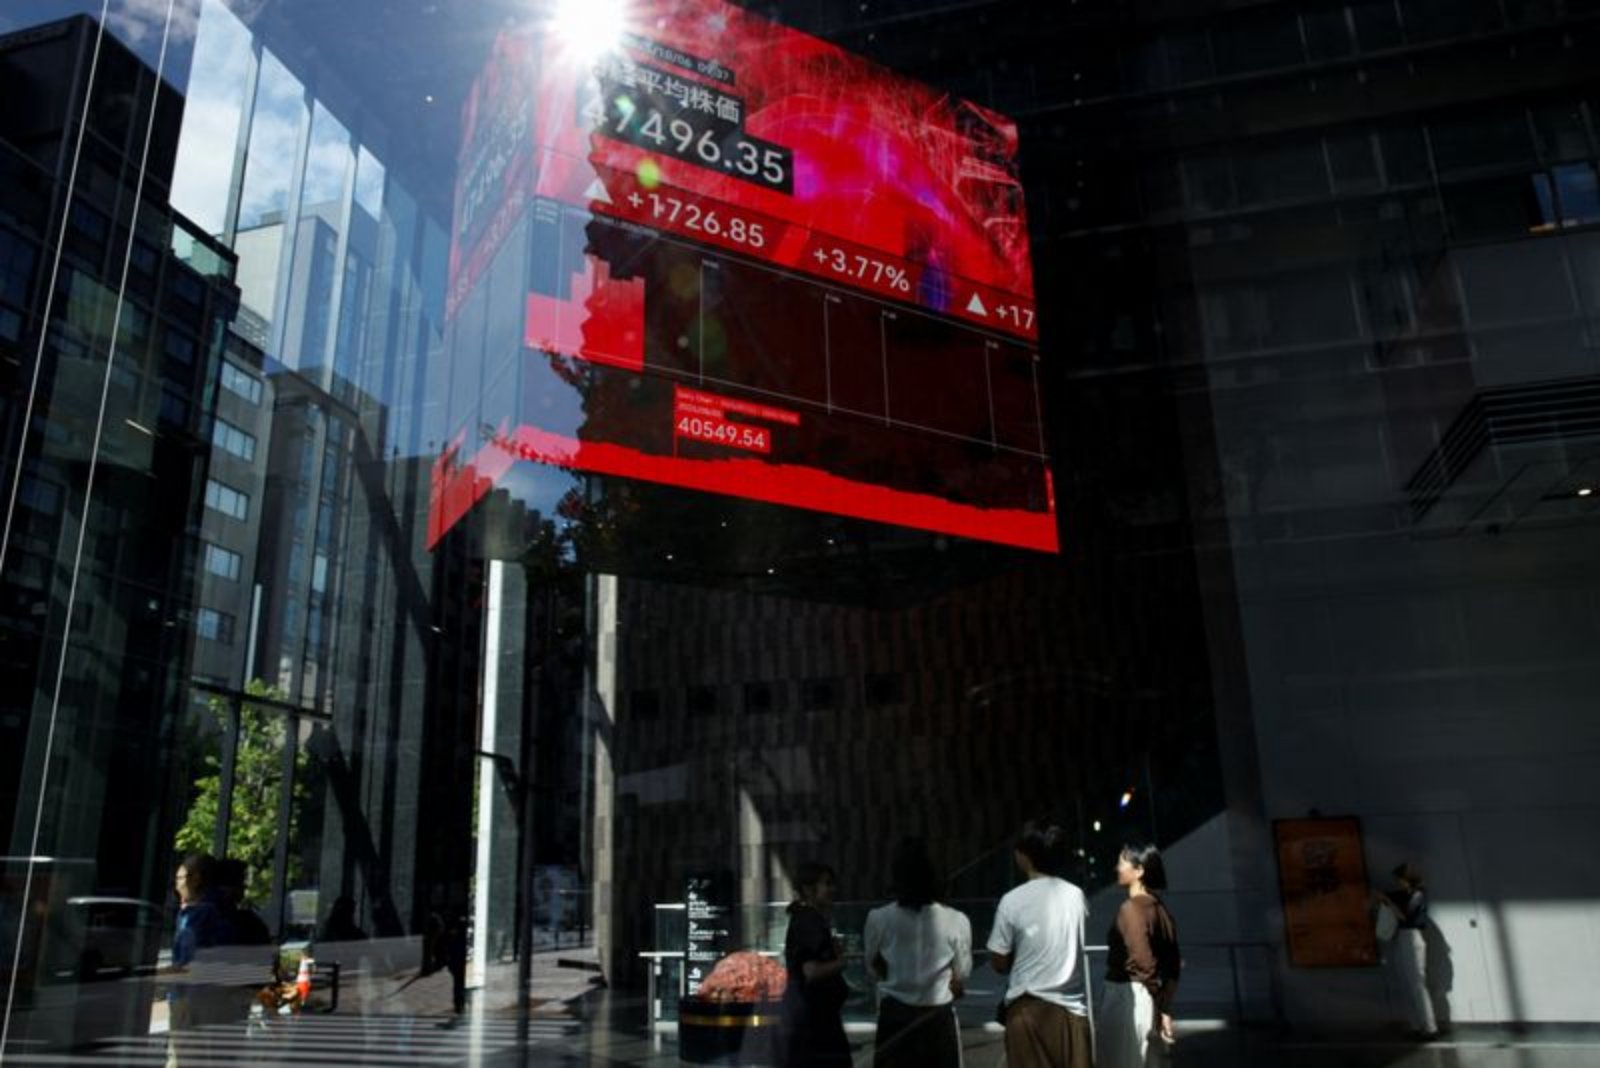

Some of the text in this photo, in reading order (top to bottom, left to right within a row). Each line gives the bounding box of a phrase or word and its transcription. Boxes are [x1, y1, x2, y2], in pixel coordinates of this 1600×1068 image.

[627, 192, 765, 247] +1726.85
[813, 248, 911, 292] +3.77%
[996, 304, 1034, 330] +17
[678, 416, 765, 448] 40549.54
